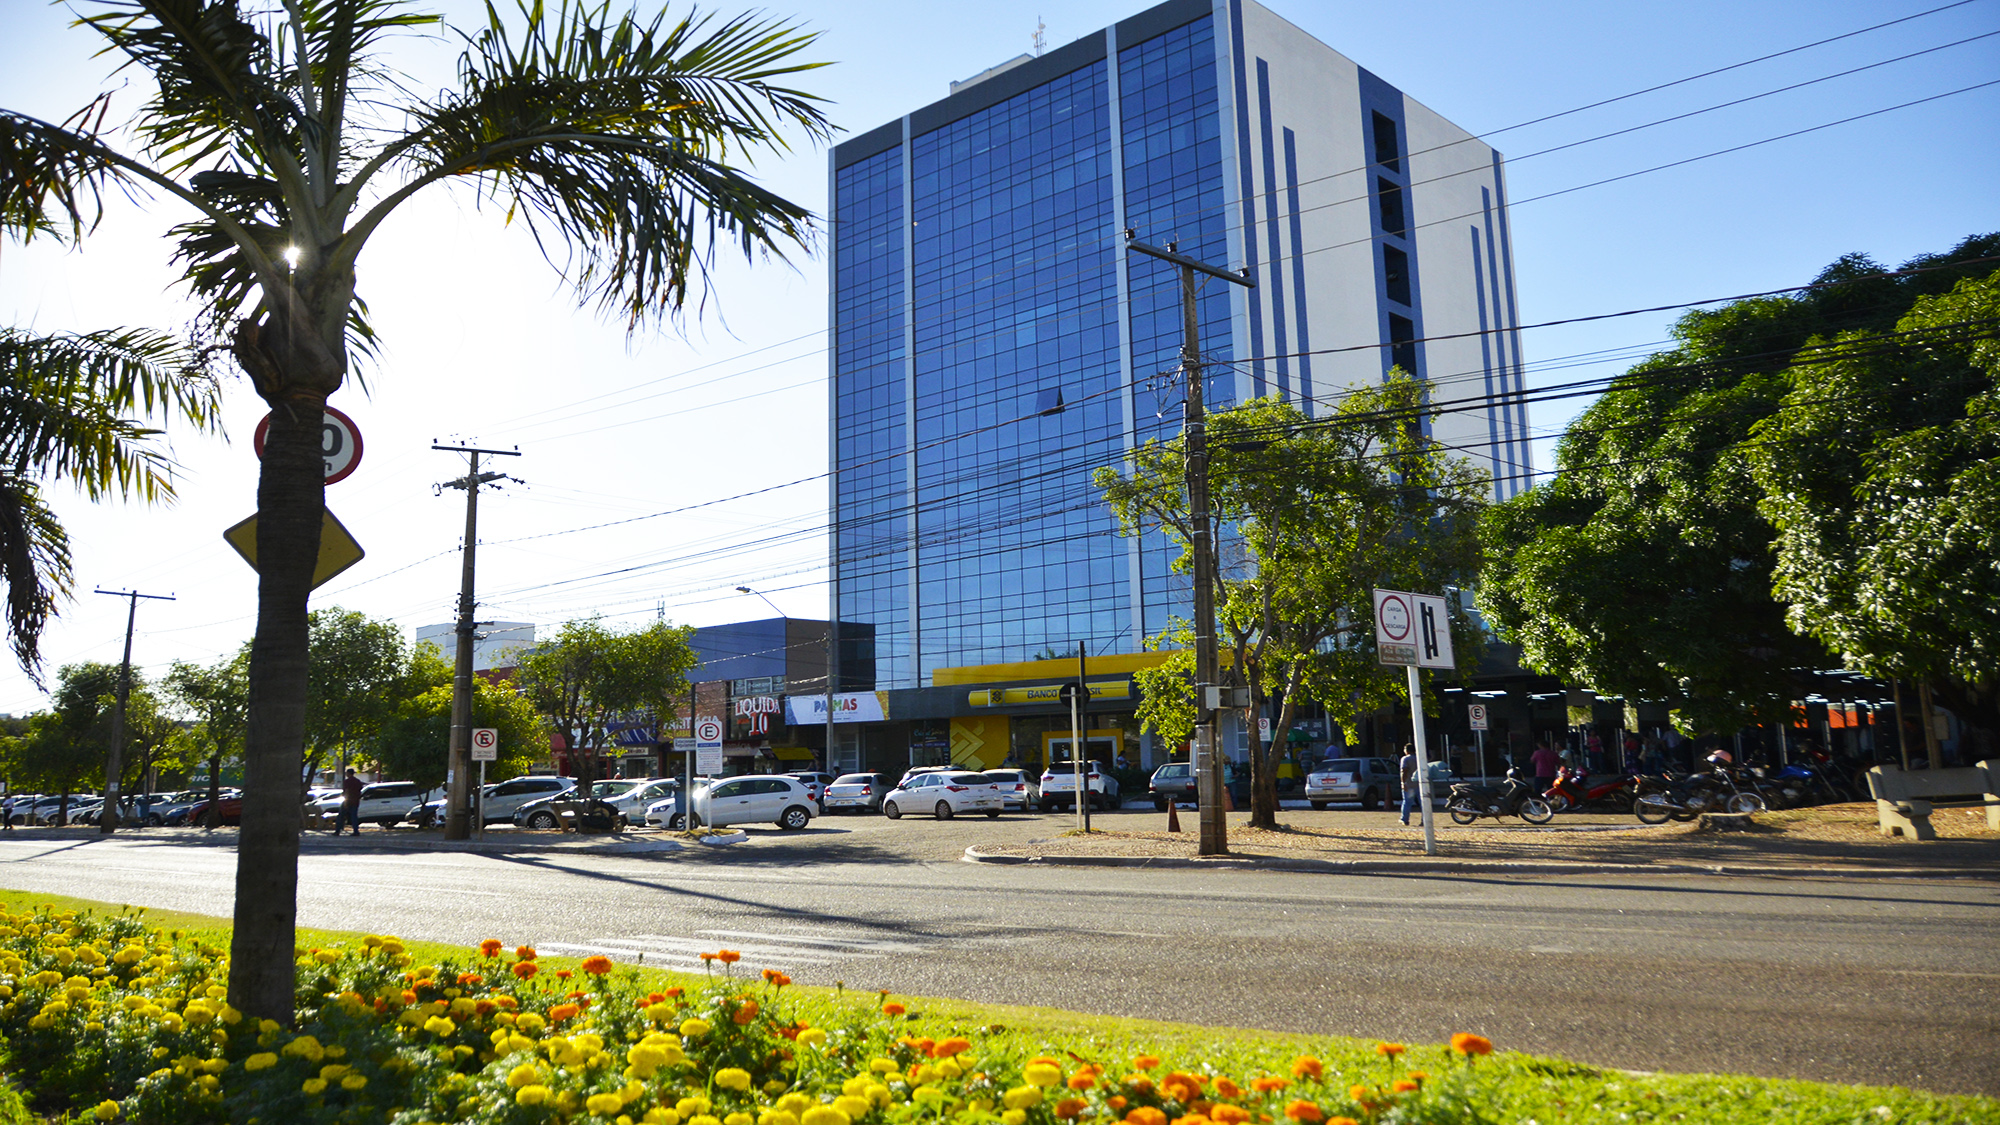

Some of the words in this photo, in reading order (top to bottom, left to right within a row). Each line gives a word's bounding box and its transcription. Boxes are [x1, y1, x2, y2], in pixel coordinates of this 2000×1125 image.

[322, 423, 344, 457] 0
[1027, 689, 1058, 699] BANCO
[735, 696, 780, 718] LIQUIDA
[814, 697, 858, 713] PAMAS
[1474, 708, 1481, 718] E
[748, 712, 769, 736] 10
[480, 733, 489, 745] E
[620, 727, 655, 742] MIX
[704, 726, 714, 738] E
